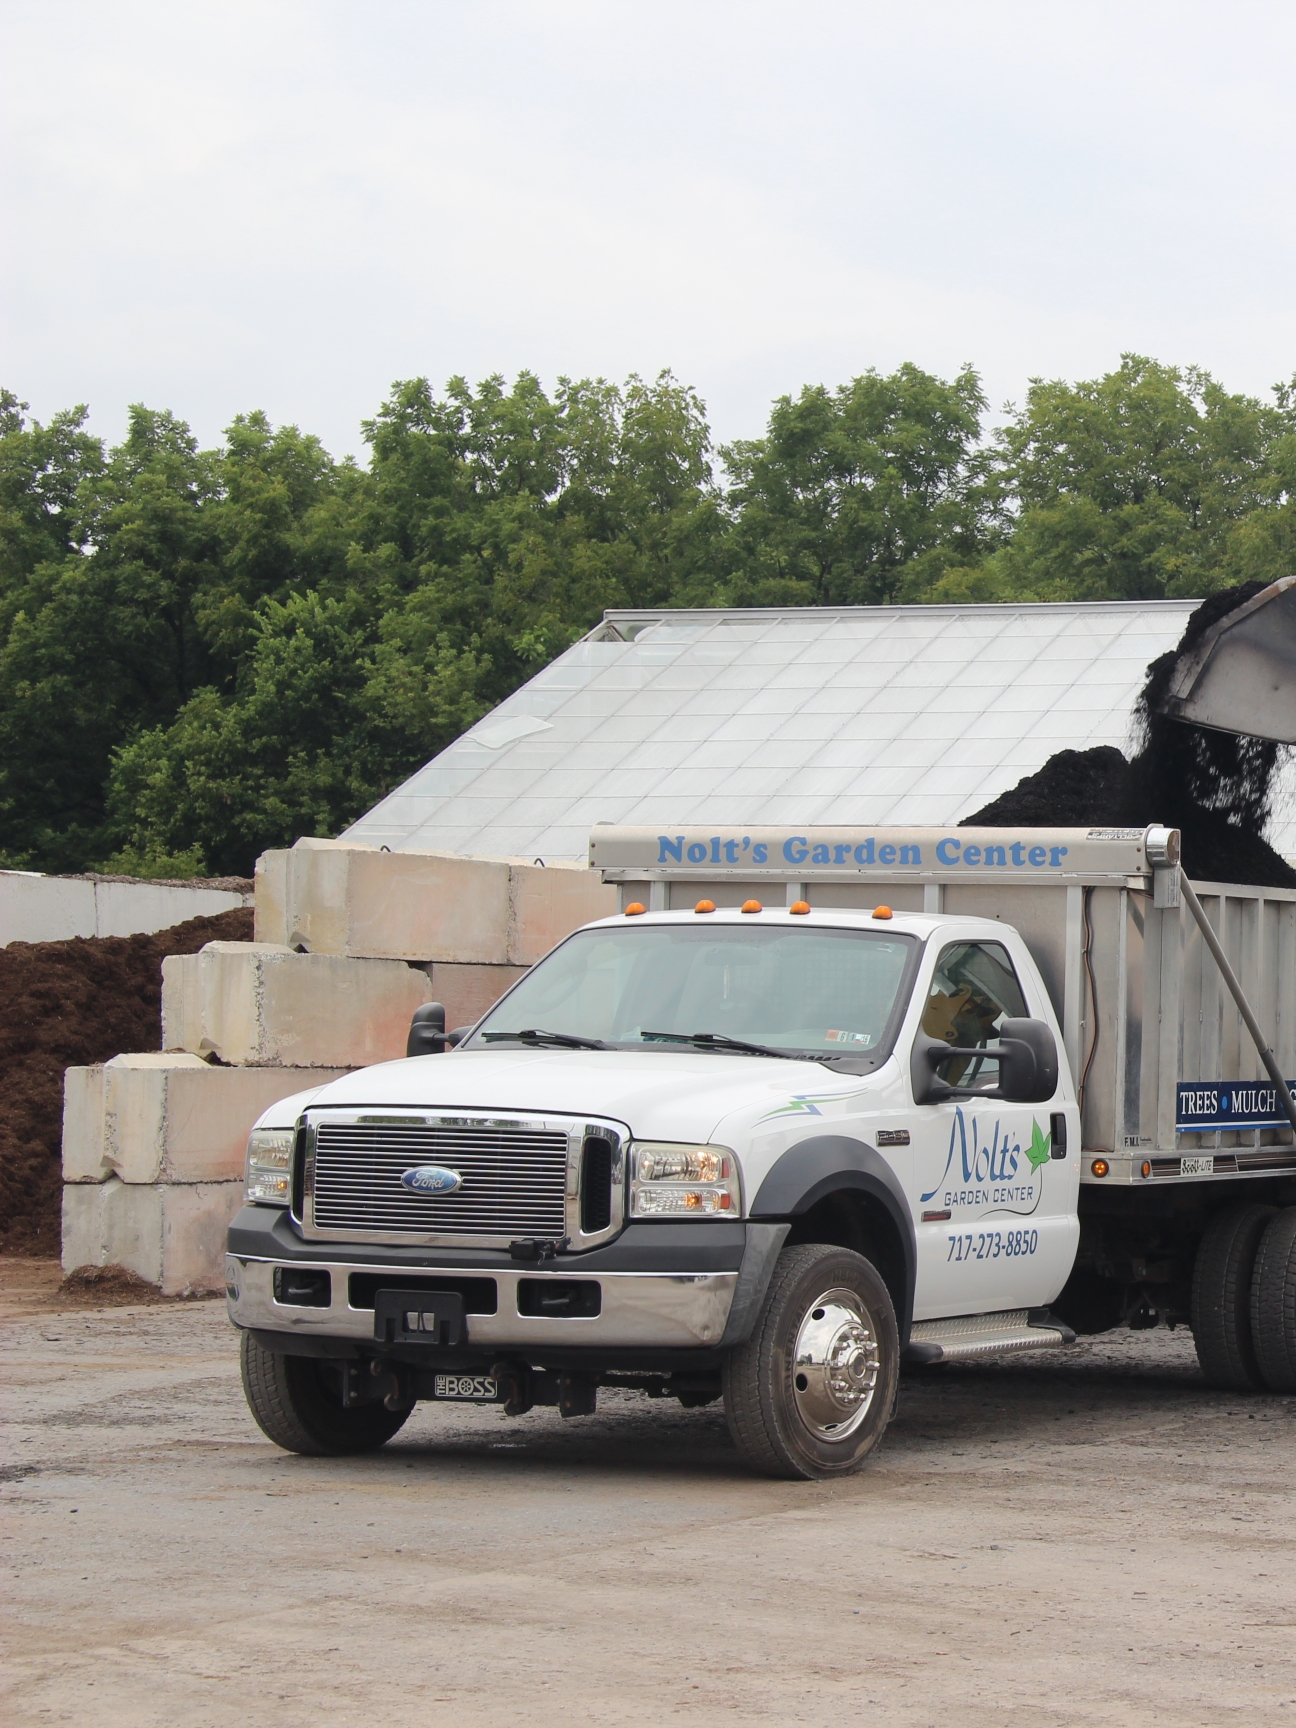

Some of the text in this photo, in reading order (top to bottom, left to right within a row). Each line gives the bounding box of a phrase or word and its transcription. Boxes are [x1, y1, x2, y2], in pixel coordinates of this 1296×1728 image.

[657, 835, 1069, 867] Nolt's Garden Center
[1180, 1090, 1218, 1115] TREES
[1231, 1090, 1277, 1113] MULCH
[920, 1105, 1021, 1203] Nolt's
[412, 1171, 445, 1190] Ford
[944, 1186, 1034, 1207] GARDEN CENTER
[947, 1229, 1038, 1262] 717-273-8850
[436, 1376, 496, 1397] THE BOSS
